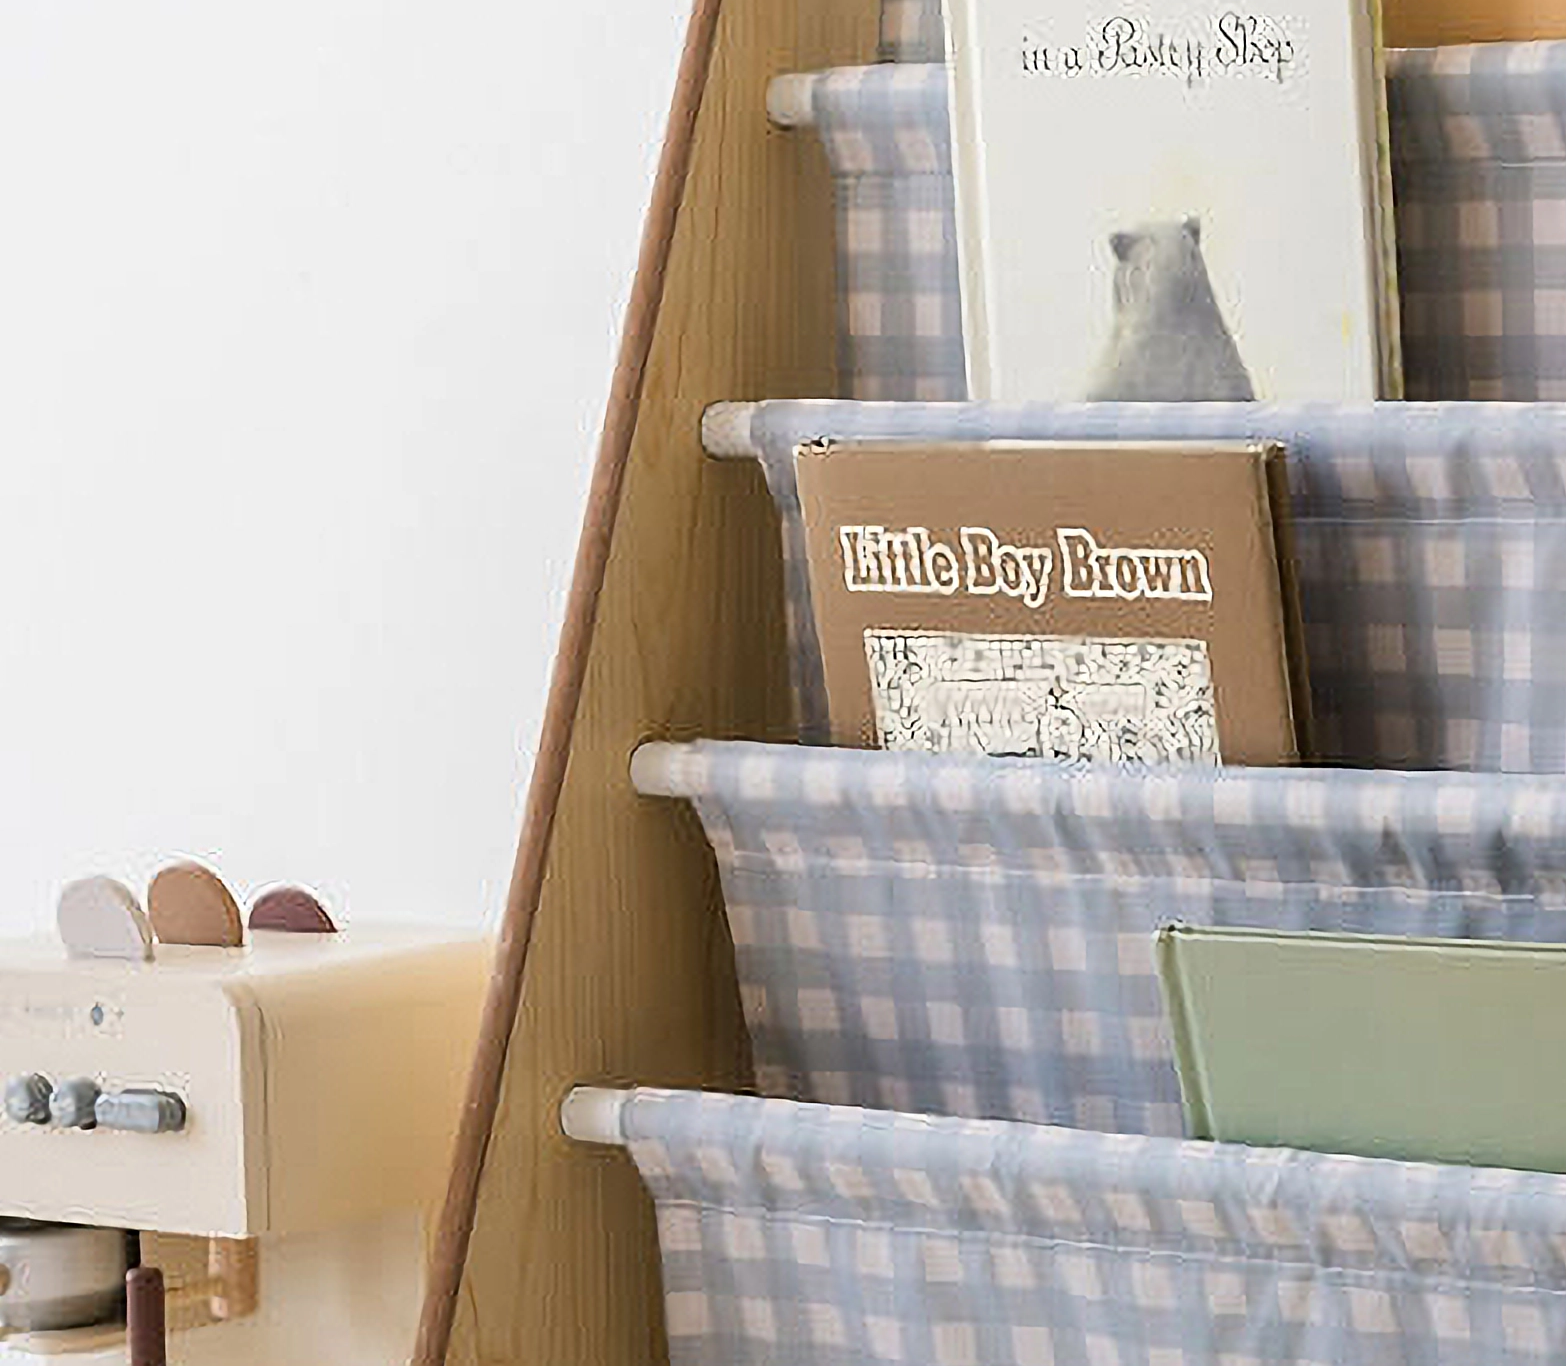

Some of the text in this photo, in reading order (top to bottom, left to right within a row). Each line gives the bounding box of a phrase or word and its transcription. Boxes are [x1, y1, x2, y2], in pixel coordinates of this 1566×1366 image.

[1021, 35, 1049, 71] in
[839, 526, 1213, 608] Little Boy Brown
